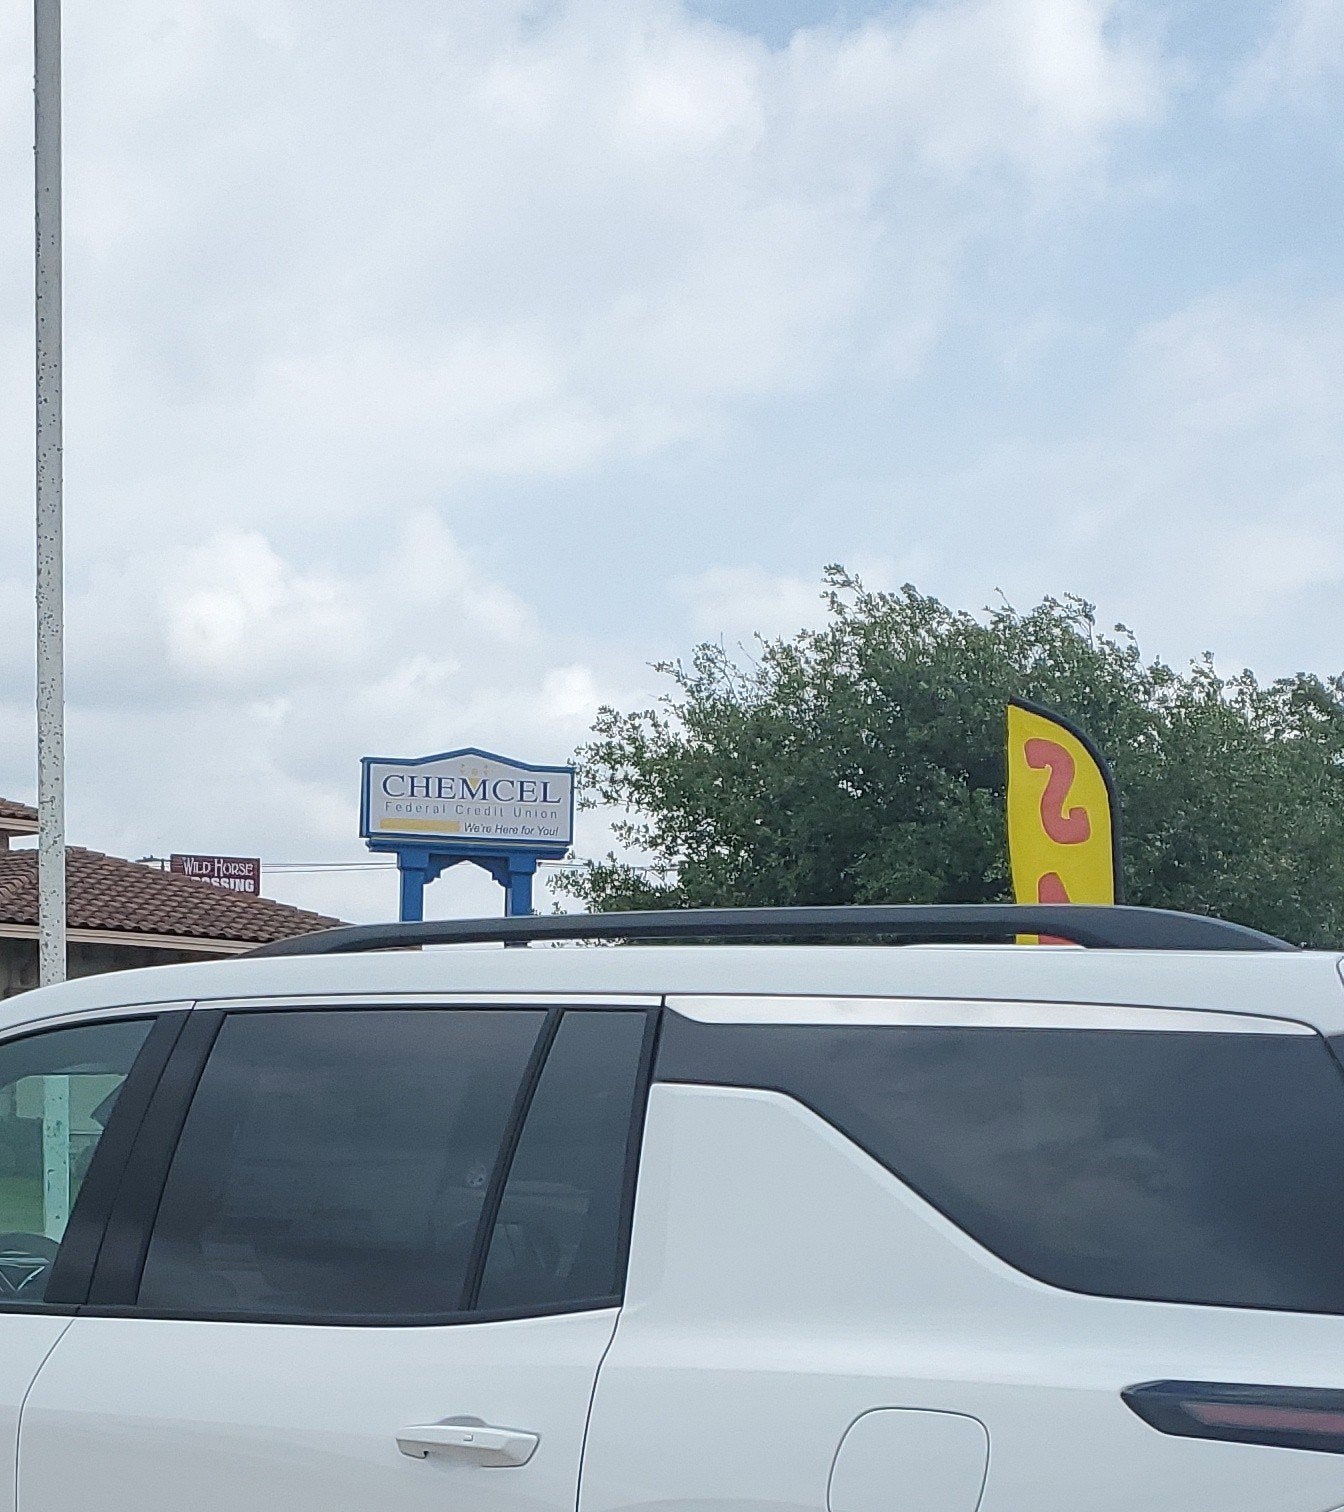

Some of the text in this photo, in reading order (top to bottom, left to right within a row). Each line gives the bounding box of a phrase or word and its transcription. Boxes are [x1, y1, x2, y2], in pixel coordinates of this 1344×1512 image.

[382, 775, 562, 804] CHEMCEL
[385, 801, 557, 819] Federal Credit Union
[464, 822, 559, 837] We're Here for You!
